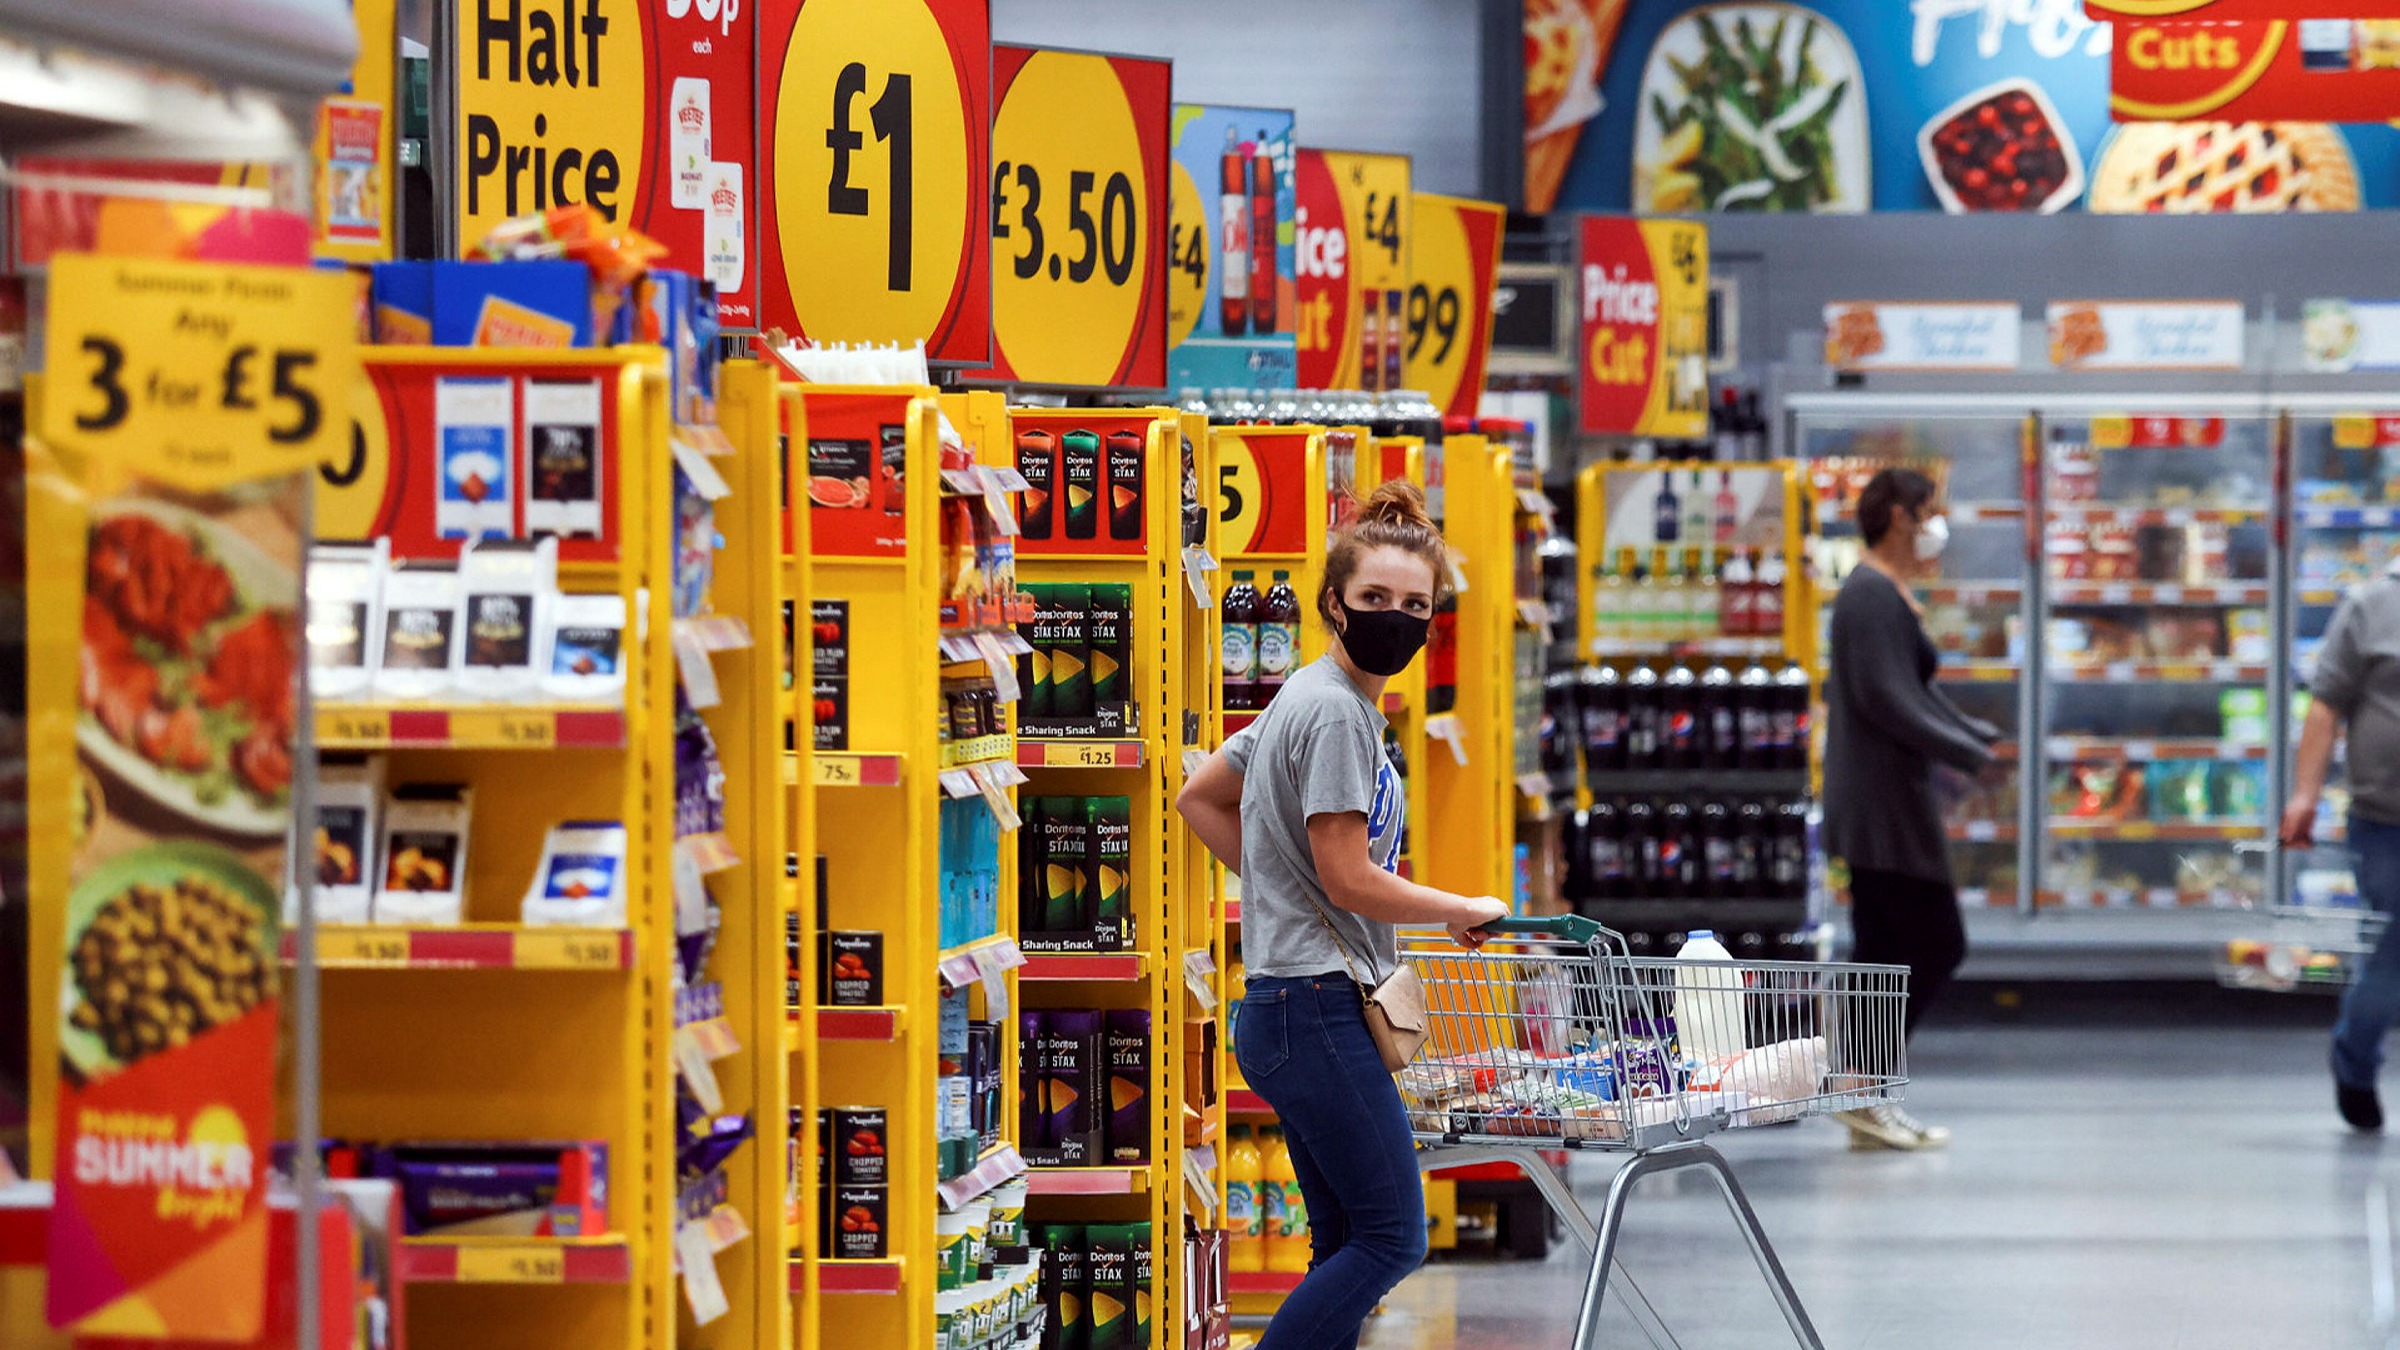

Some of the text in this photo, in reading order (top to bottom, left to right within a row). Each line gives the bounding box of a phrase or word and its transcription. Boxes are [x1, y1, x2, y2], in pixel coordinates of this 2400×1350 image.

[477, 0, 608, 88] Half
[693, 37, 712, 54] each
[2127, 27, 2240, 69] Cuts
[678, 106, 704, 126] VEETEE
[468, 114, 620, 221] Price
[825, 62, 912, 292] £1
[993, 160, 1136, 287] £3.50
[1364, 192, 1400, 266] £4
[1296, 206, 1347, 279] ice
[1170, 222, 1204, 290] £4
[1583, 263, 1659, 326] Price
[1297, 289, 1332, 351] ut
[1590, 327, 1647, 386] Cut
[75, 335, 130, 431] 3
[220, 345, 322, 445] £5
[1022, 456, 1048, 465] Doritos
[1066, 456, 1093, 465] Doritos
[1111, 456, 1138, 465] Doritos
[1025, 468, 1046, 477] STAX
[1069, 468, 1091, 477] STAX
[1114, 468, 1135, 477] STAX
[810, 605, 843, 617] apolina
[1033, 626, 1051, 638] STAX
[1054, 626, 1081, 638] STAX
[1092, 626, 1116, 638] STAX
[1100, 720, 1117, 728] STAX
[1025, 725, 1064, 736] Sharing
[1065, 725, 1096, 734] Snack
[1080, 752, 1111, 765] £1.25
[1097, 825, 1121, 834] Doritos
[1101, 840, 1120, 852] STAX
[1023, 940, 1093, 950] Sharing Snack
[1049, 1041, 1078, 1049] Doritos
[1109, 1037, 1143, 1047] Doritos
[1052, 1055, 1076, 1067] STAX
[1113, 1053, 1140, 1064] STAX
[848, 1114, 884, 1126] Napolina
[75, 1135, 253, 1190] SUMMER
[849, 1157, 884, 1166] CHOPPED
[1036, 1157, 1060, 1165] Snack
[841, 1191, 879, 1202] Napolina
[843, 1234, 878, 1243] CHOPPED
[1090, 1252, 1125, 1262] Doritos
[1094, 1268, 1122, 1280] STAX
